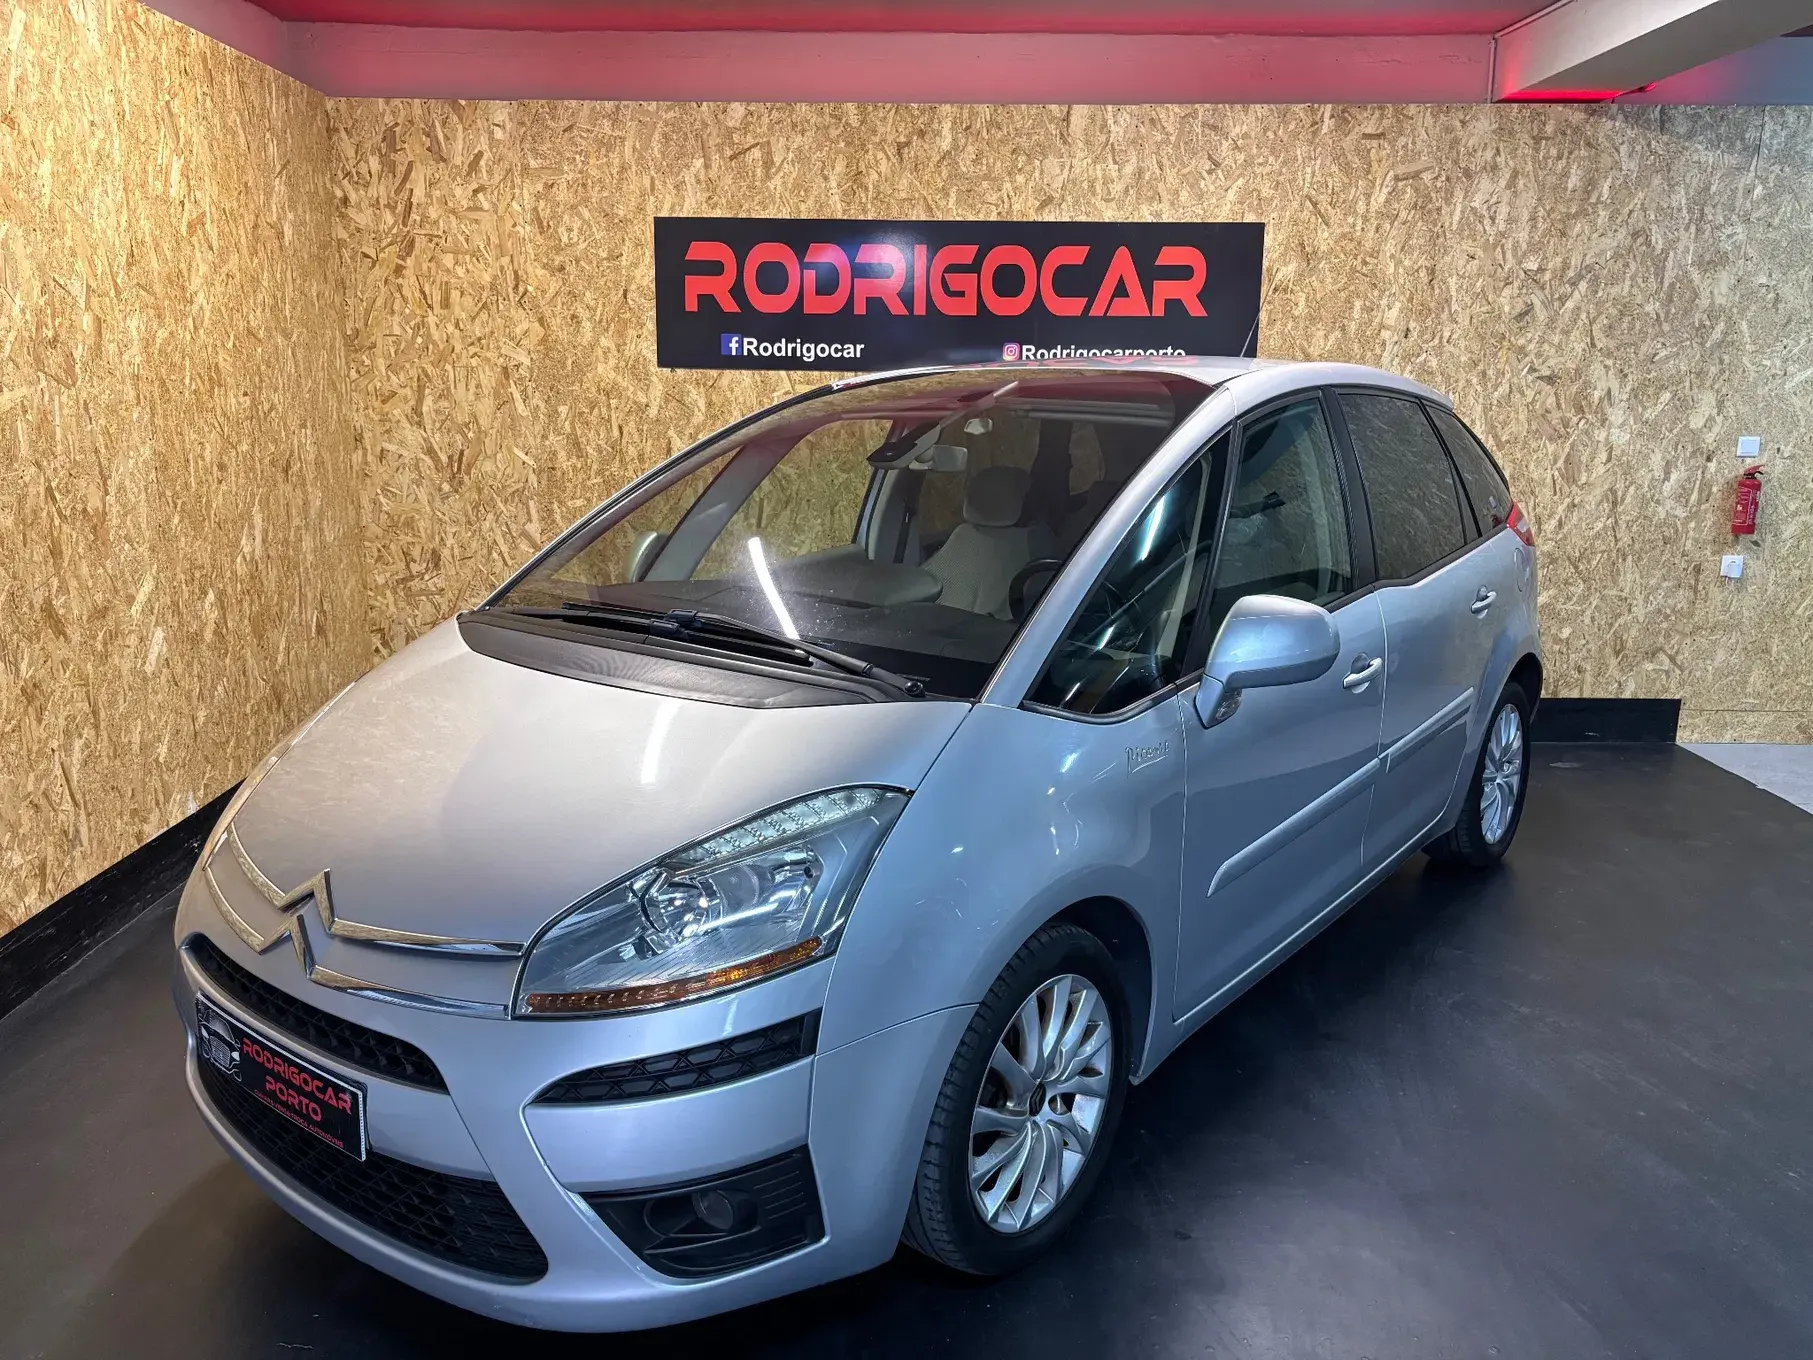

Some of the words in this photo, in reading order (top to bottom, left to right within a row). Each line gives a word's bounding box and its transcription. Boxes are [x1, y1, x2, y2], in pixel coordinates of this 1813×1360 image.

[684, 241, 1208, 317] RODRIGOCAR
[742, 337, 865, 362] Rodrigocar
[242, 1037, 352, 1115] RODRIGOCAR
[265, 1075, 322, 1121] PORTO
